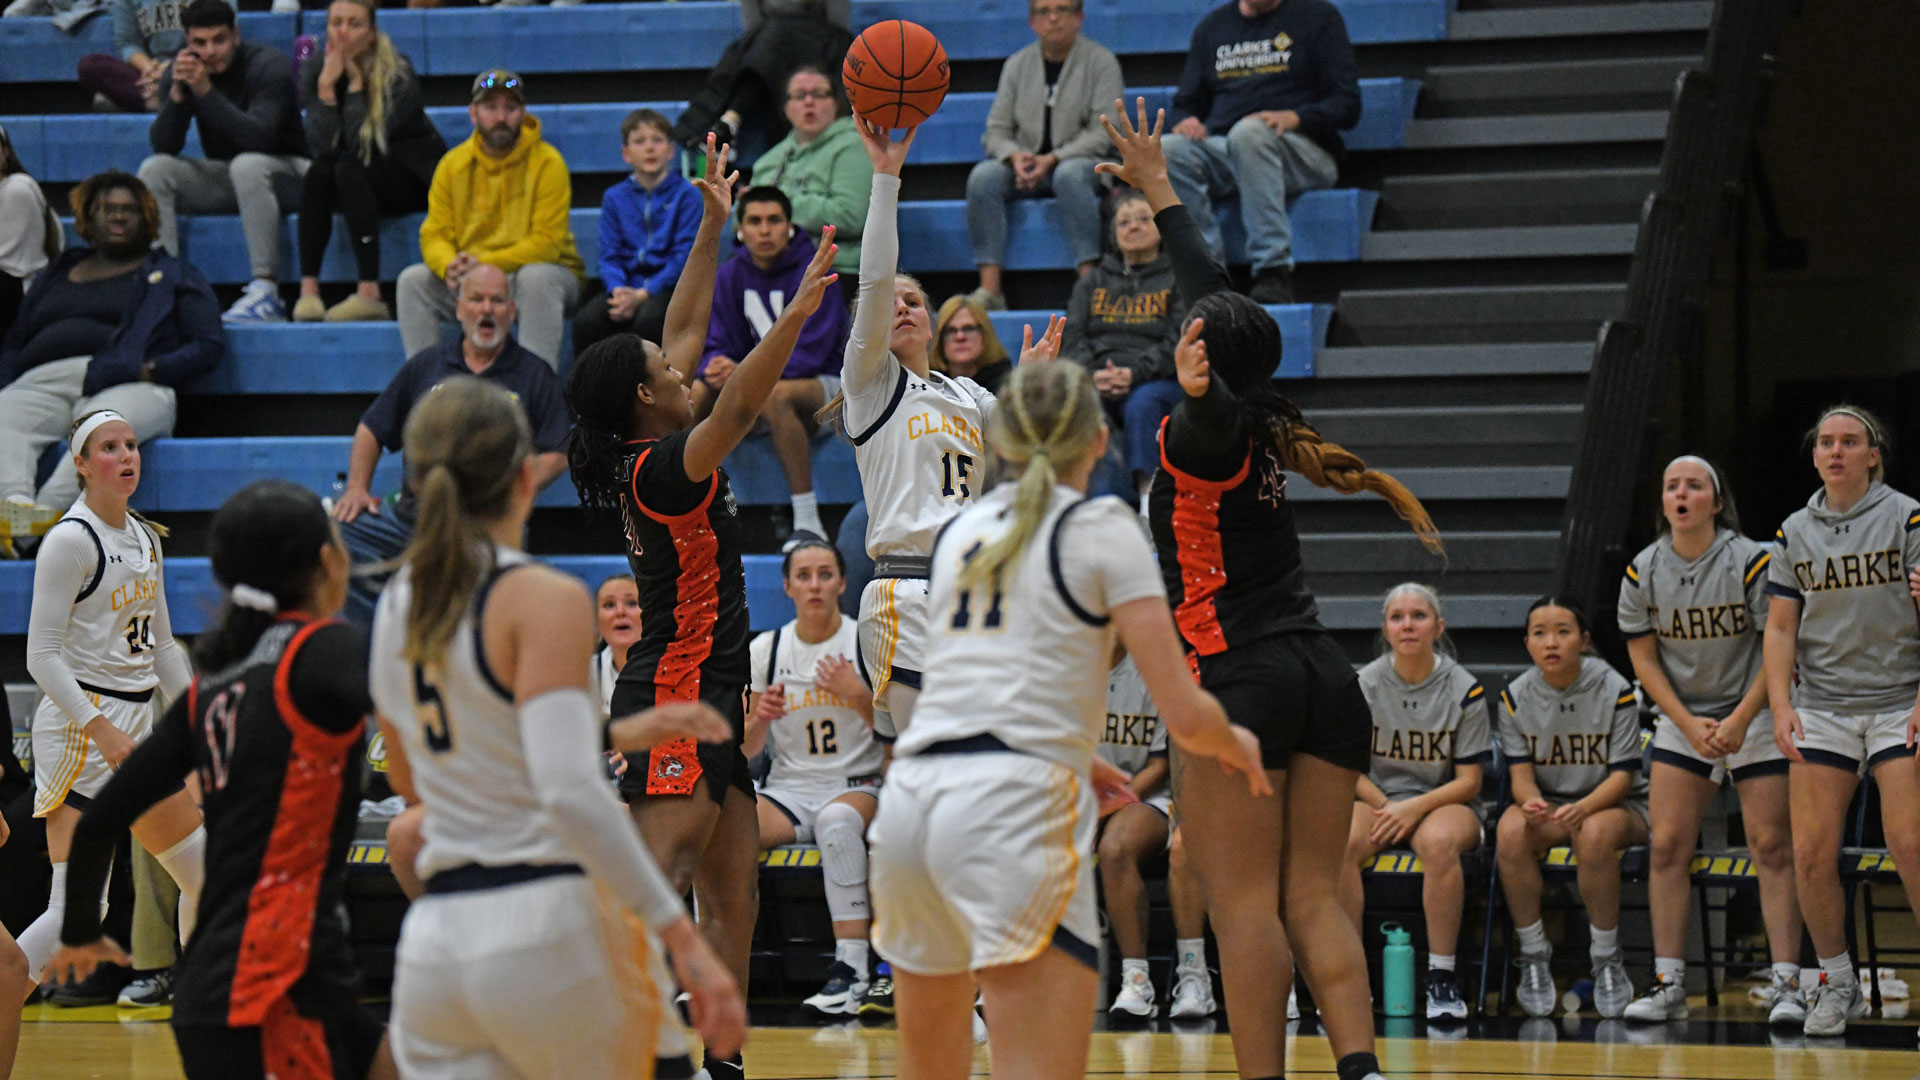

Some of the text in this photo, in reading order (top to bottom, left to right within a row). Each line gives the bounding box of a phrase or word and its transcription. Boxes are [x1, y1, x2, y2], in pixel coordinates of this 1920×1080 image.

[1215, 51, 1292, 72] UNIVERSITY
[1216, 39, 1272, 59] CLARKE
[743, 288, 785, 341] N
[940, 449, 974, 501] 15
[1793, 548, 1904, 593] CLARKE
[126, 614, 154, 655] 24
[804, 717, 840, 757] 12
[1099, 711, 1159, 747] RKE
[1520, 732, 1612, 766] LARK
